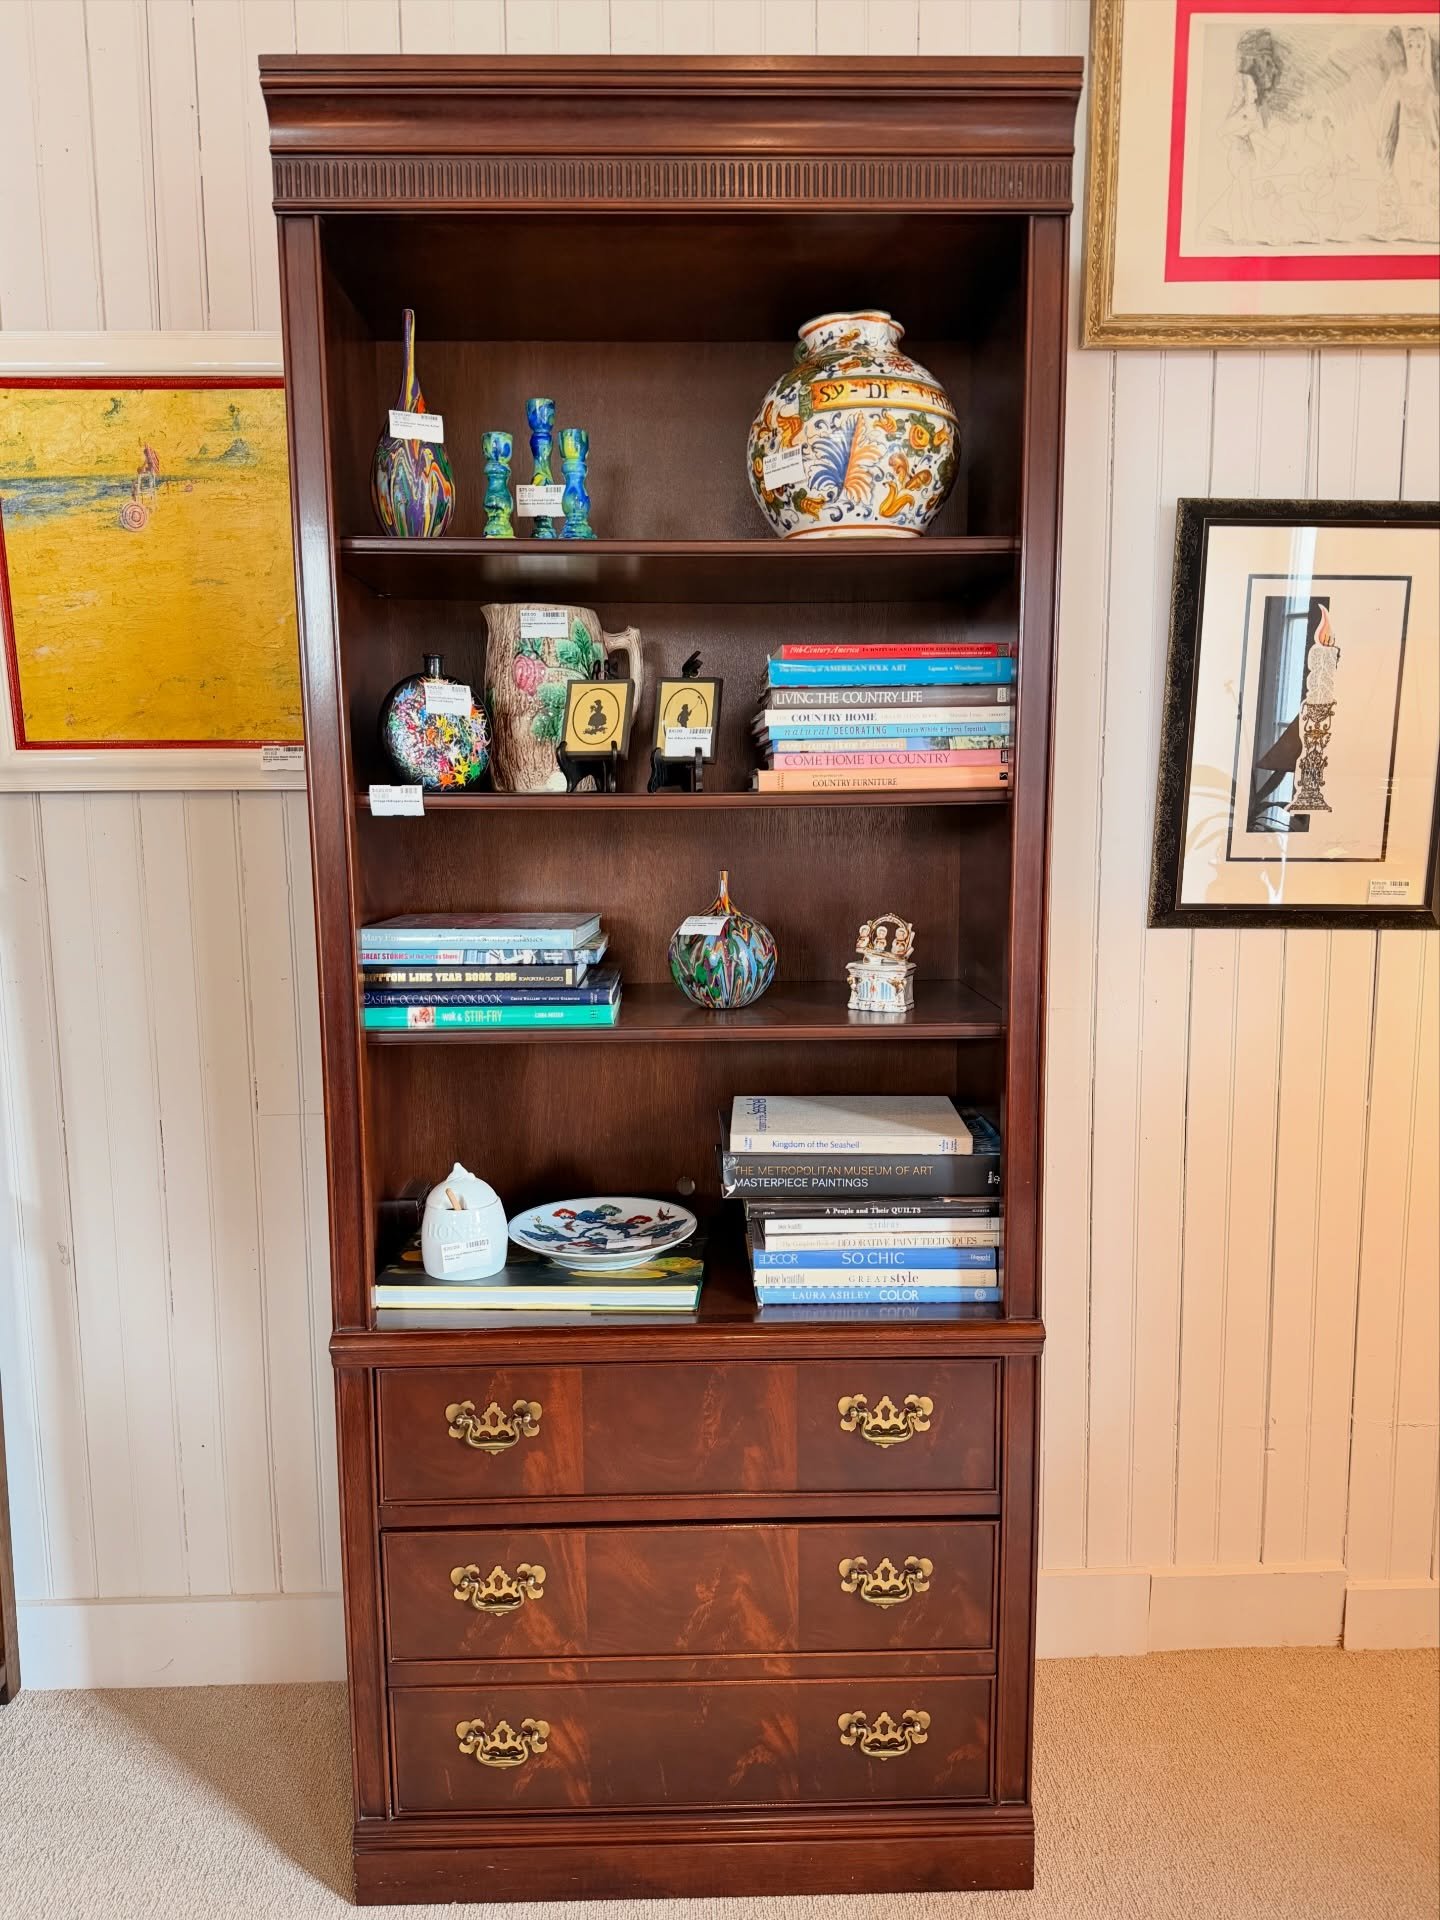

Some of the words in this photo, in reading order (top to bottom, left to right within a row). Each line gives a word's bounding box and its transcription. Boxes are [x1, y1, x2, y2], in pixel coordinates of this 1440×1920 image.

[824, 664, 868, 673] AMERICAN
[868, 664, 890, 672] FOLK
[891, 663, 908, 672] ART
[775, 691, 814, 705] LIVING
[816, 691, 836, 704] THE
[842, 690, 898, 704] COUNTRY
[901, 690, 923, 703] LIFE
[791, 713, 842, 722] COUNTRY
[845, 712, 878, 722] HOME
[784, 726, 830, 737] natural
[833, 725, 887, 736] DECORATING
[784, 754, 822, 767] COME
[826, 754, 865, 766] HOME
[870, 753, 885, 766] TO
[888, 752, 951, 765] COUNTRY
[812, 778, 852, 788] COUNTRY
[852, 777, 897, 787] FURNITURE
[361, 952, 381, 960] GREAT
[382, 952, 409, 960] STORIES
[408, 972, 433, 982] LINE
[435, 972, 463, 982] YEAR
[465, 972, 492, 982] BOOK
[363, 992, 395, 1005] CASUAL
[399, 994, 449, 1004] OCCASIONS
[450, 994, 503, 1004] COOKBOOK
[442, 1011, 457, 1022] wok
[464, 1010, 503, 1023] STIR-FRY
[772, 1140, 806, 1150] Kingdom
[806, 1140, 815, 1148] of
[816, 1140, 829, 1148] the
[830, 1140, 860, 1149] Seashell
[735, 1166, 753, 1176] THE
[757, 1166, 842, 1176] METROPOLITAN
[844, 1166, 892, 1176] MUSEUM
[895, 1165, 911, 1176] OF
[912, 1165, 934, 1176] ART
[735, 1178, 809, 1188] MASTERPIECE
[812, 1178, 869, 1188] PAINTINGS
[832, 1207, 854, 1216] People
[890, 1206, 921, 1214] QUILTS
[838, 1238, 891, 1248] DECORATIVE
[893, 1237, 919, 1246] PAINT
[919, 1236, 977, 1247] TECHNIQUES
[763, 1253, 799, 1264] DECOR
[841, 1252, 864, 1265] SO
[867, 1252, 905, 1264] CHIC
[848, 1274, 889, 1283] GREAT
[890, 1271, 919, 1286] style
[792, 1290, 827, 1300] LAURA
[830, 1290, 871, 1300] ASHLEY
[879, 1289, 920, 1301] COLOR
